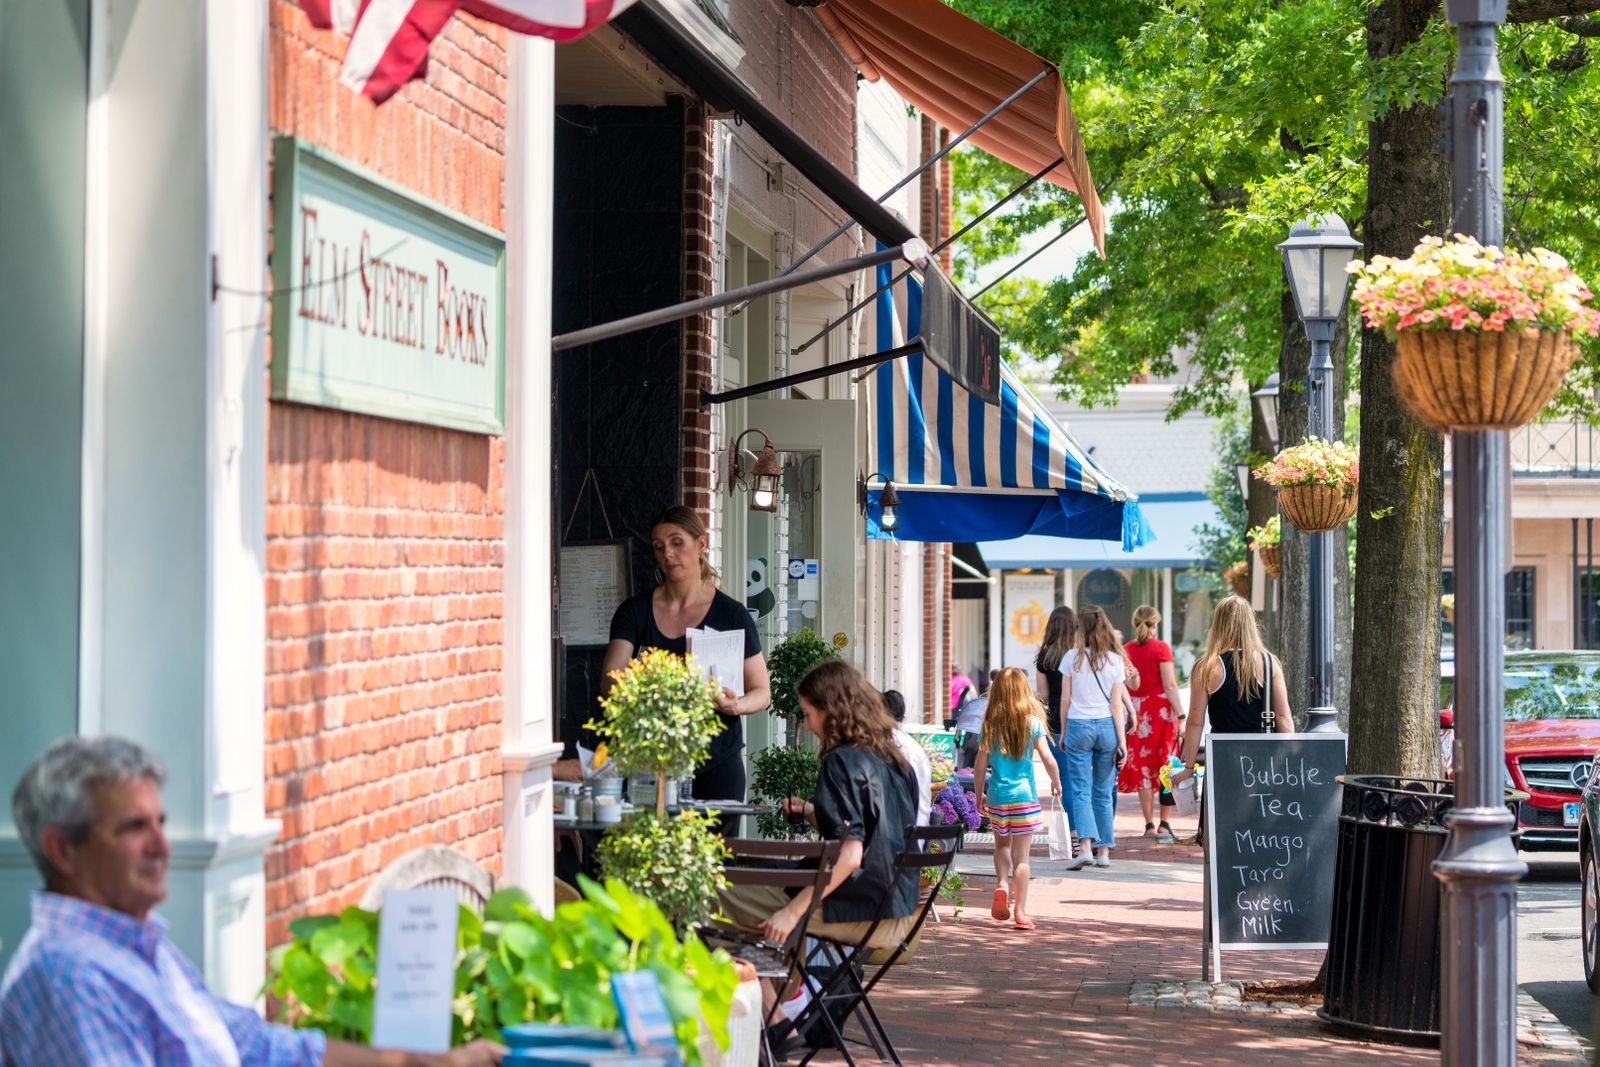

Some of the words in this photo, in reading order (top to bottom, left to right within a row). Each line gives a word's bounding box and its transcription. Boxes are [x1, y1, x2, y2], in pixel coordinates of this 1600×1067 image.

[436, 259, 489, 367] BOOKS
[1231, 865, 1284, 888] Taro
[1241, 913, 1283, 938] Milk
